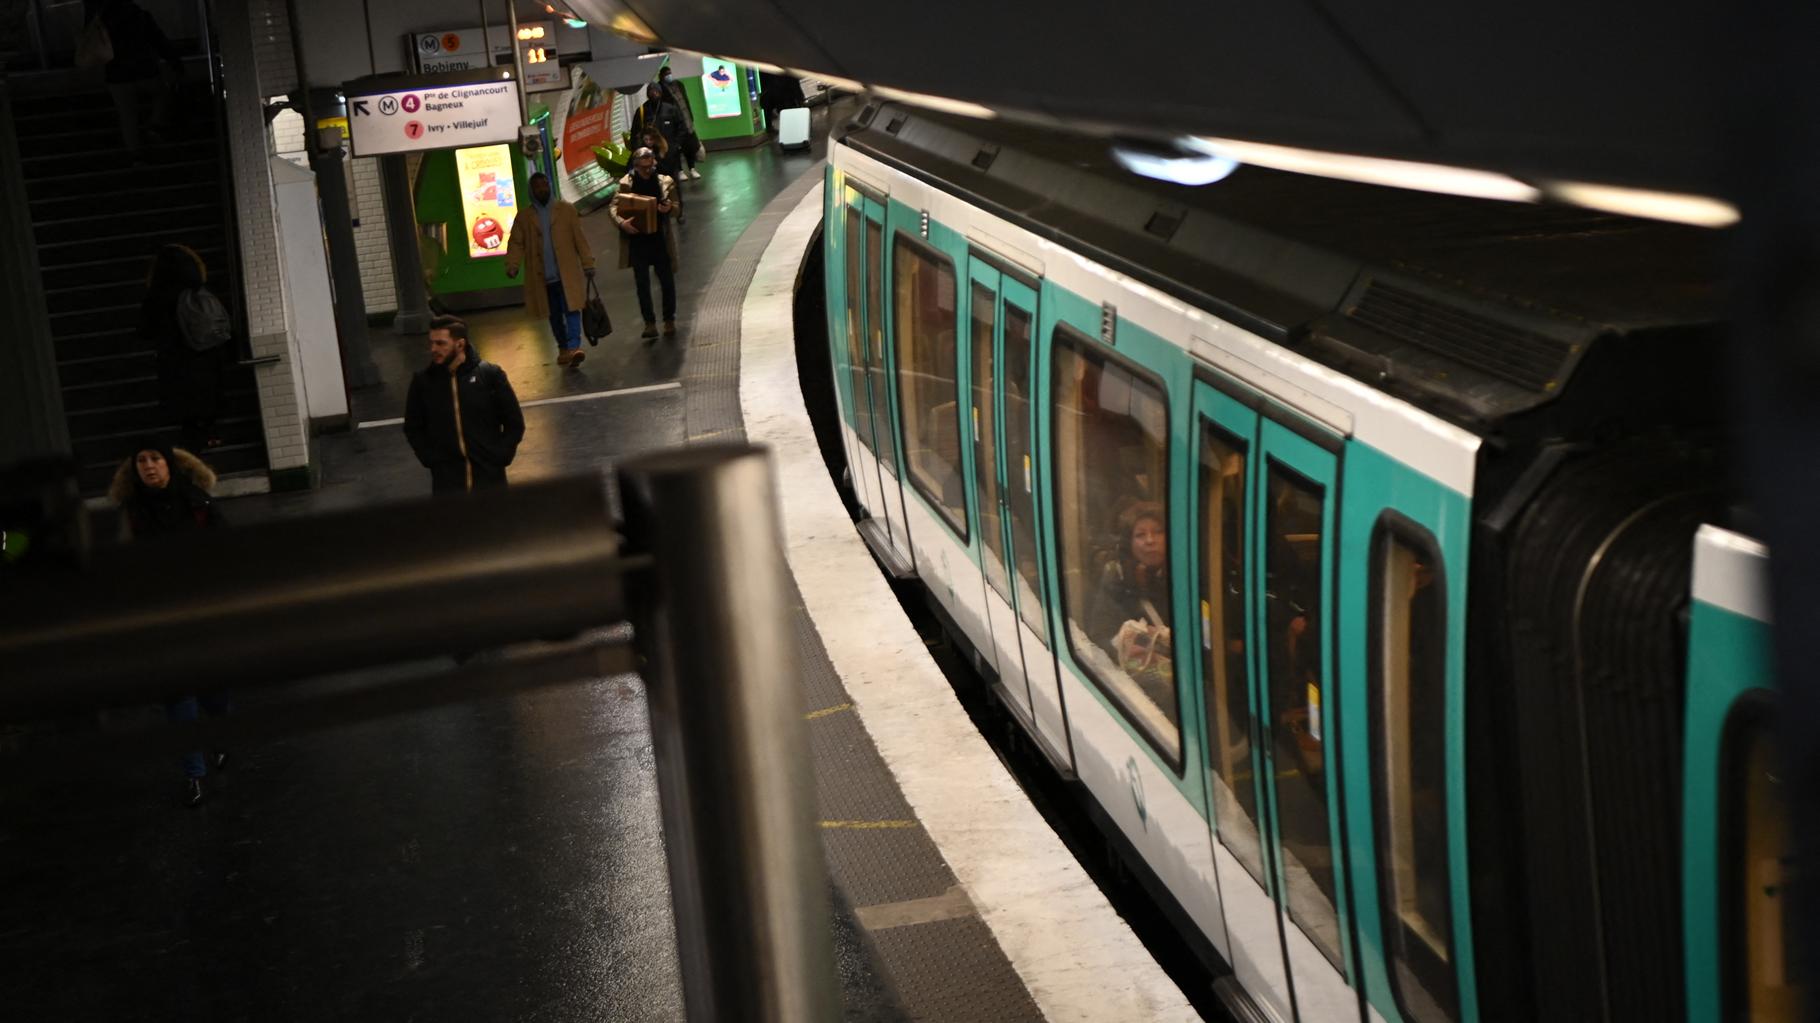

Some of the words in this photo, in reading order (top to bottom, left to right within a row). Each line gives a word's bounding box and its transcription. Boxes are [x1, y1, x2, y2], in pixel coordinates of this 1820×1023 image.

[423, 60, 469, 73] Bobigny
[438, 90, 449, 99] de
[452, 86, 508, 99] Clignancourt
[425, 101, 464, 112] Bagneux
[428, 123, 445, 133] Ivry
[453, 118, 488, 131] Villejuif
